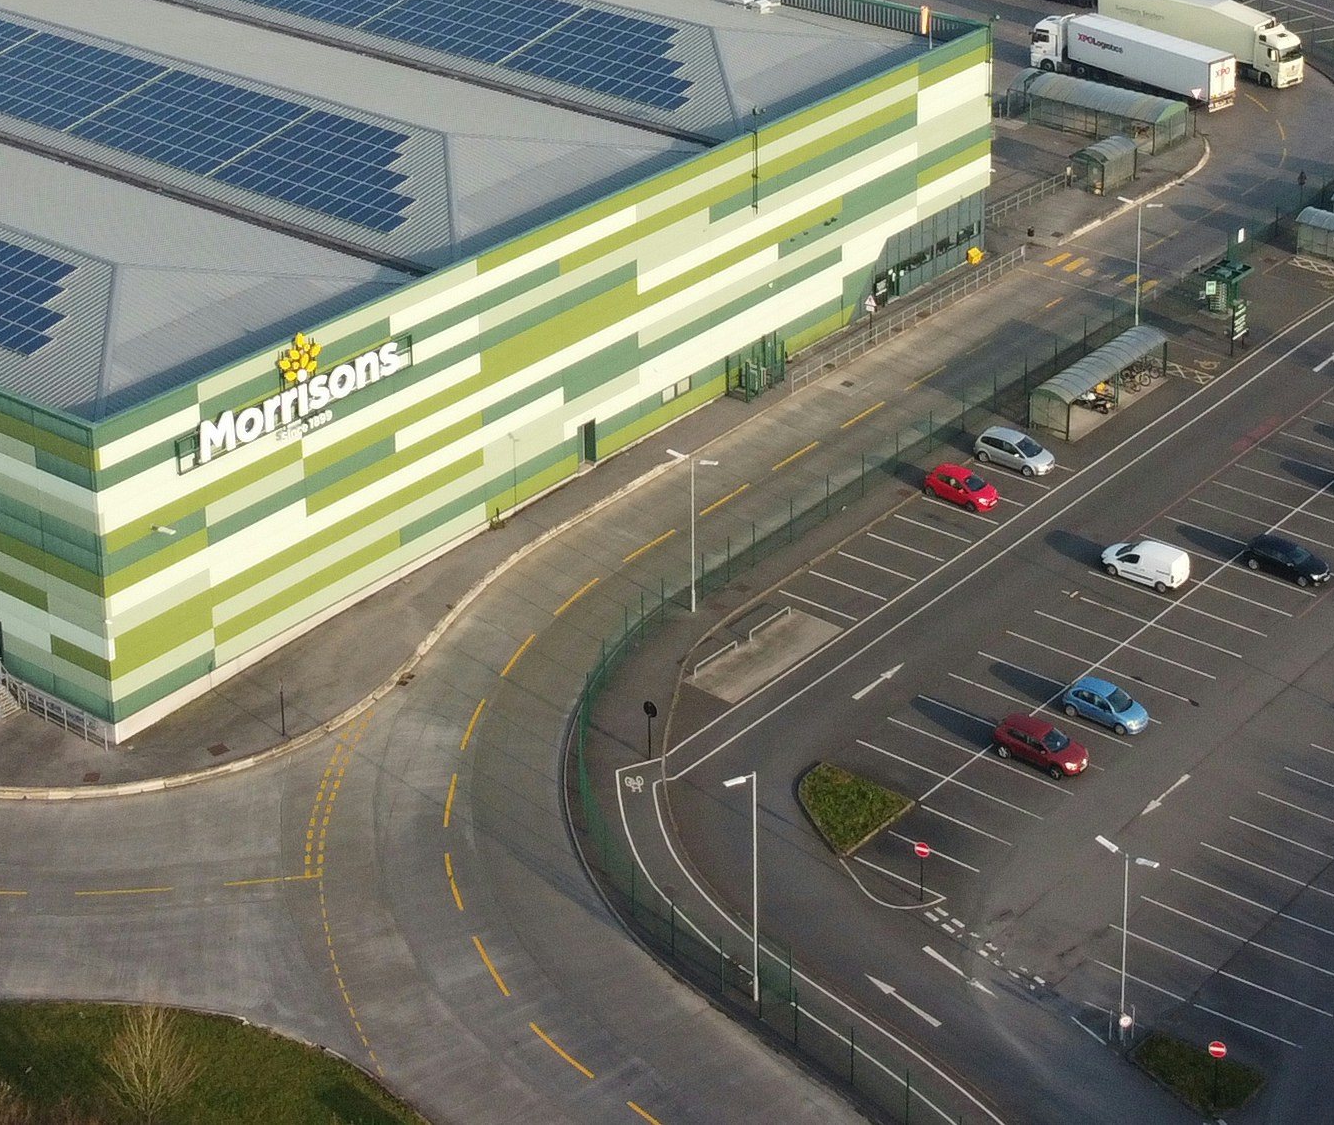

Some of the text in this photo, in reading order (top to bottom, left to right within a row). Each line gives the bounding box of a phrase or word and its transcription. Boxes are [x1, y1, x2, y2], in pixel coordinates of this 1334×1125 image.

[1214, 67, 1231, 78] XPO
[199, 341, 402, 464] Morrisons
[308, 409, 333, 430] 1899
